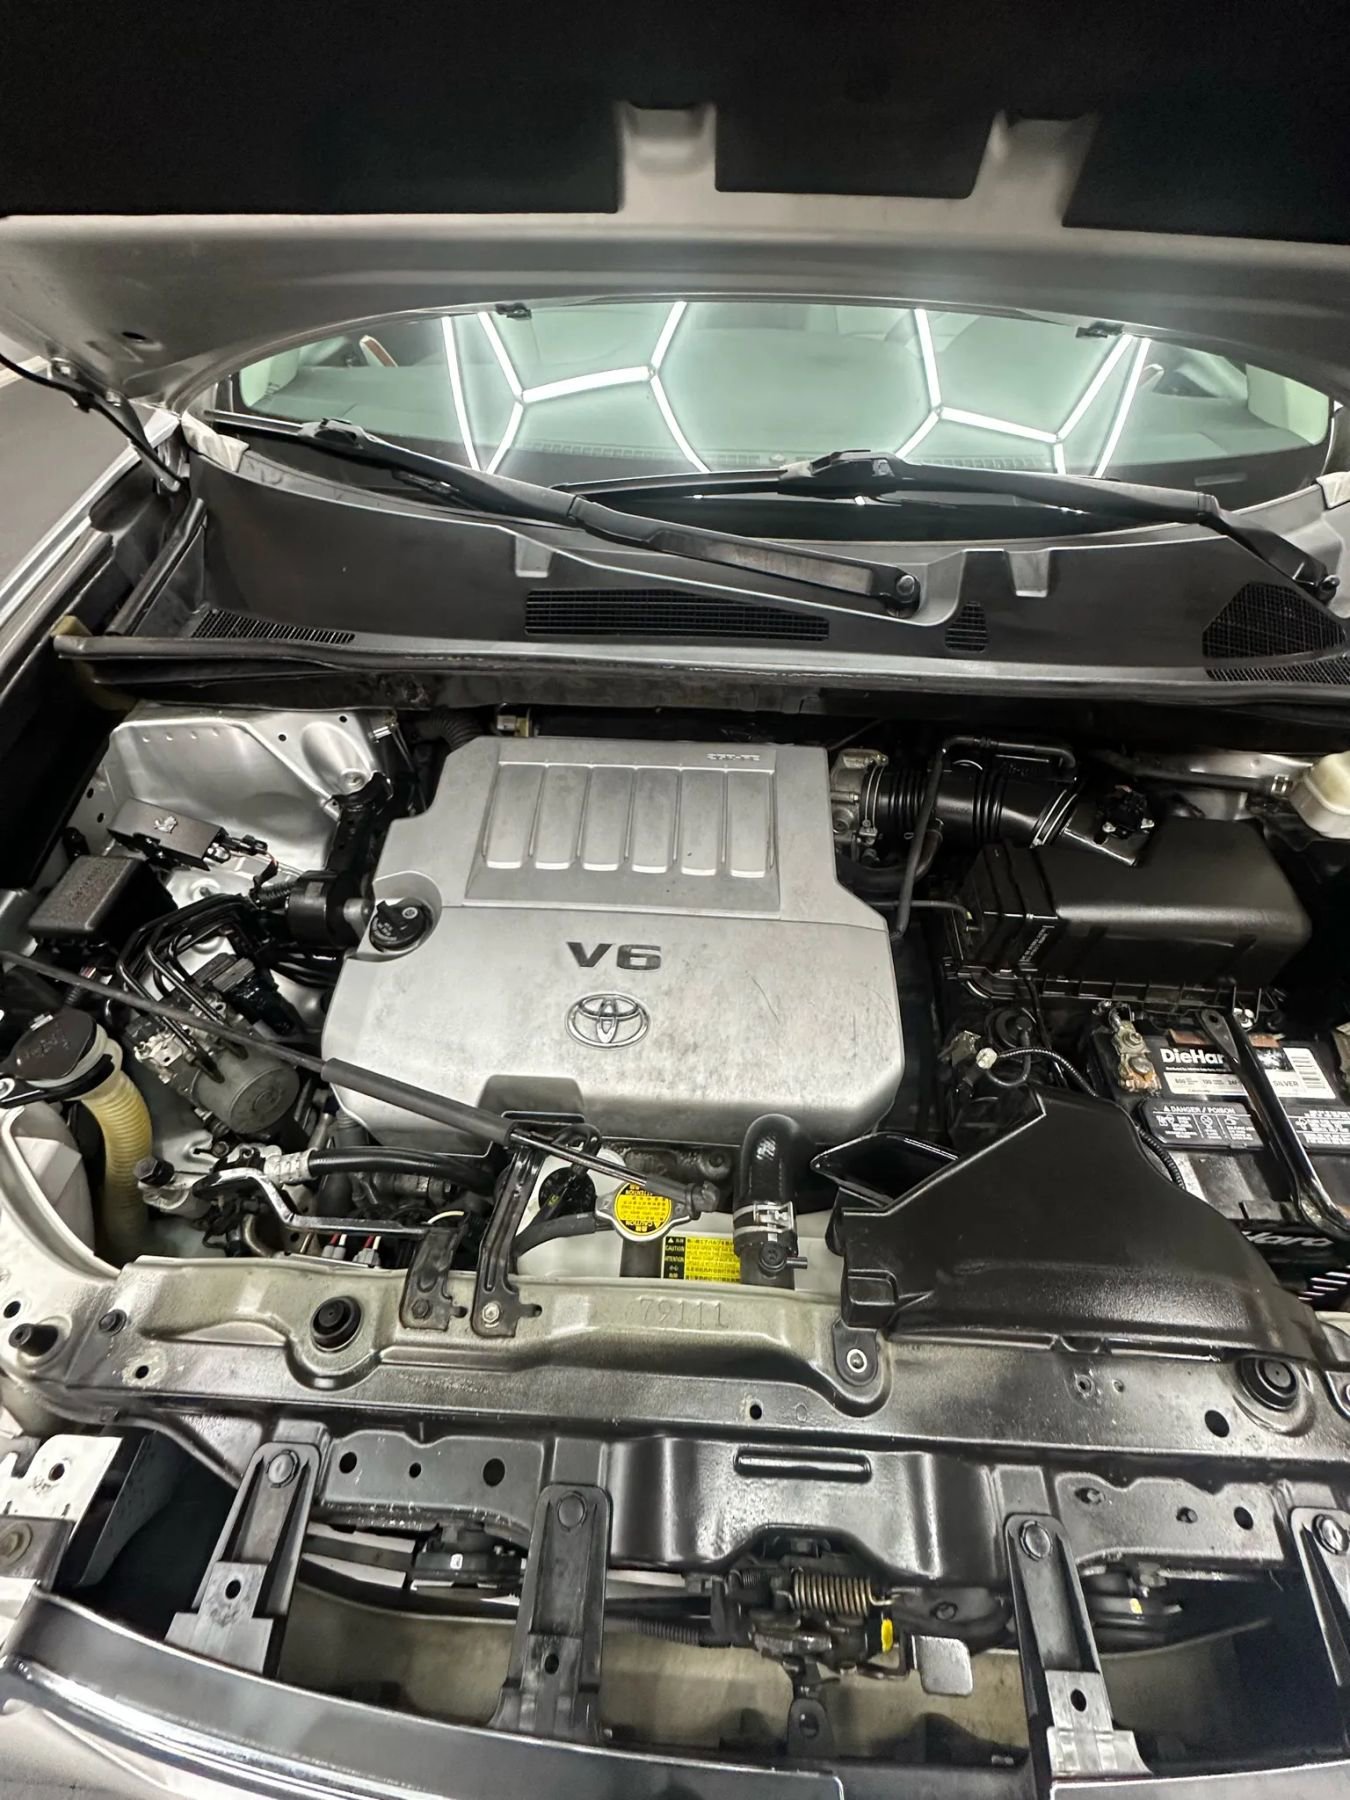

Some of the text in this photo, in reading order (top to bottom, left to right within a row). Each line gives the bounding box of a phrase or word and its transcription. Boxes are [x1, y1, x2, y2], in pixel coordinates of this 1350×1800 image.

[565, 941, 661, 971] V6
[1160, 1048, 1225, 1064] DieHar
[1170, 1105, 1201, 1113] DANGER
[1208, 1106, 1236, 1114] POISON
[665, 1244, 685, 1252] CAUTION
